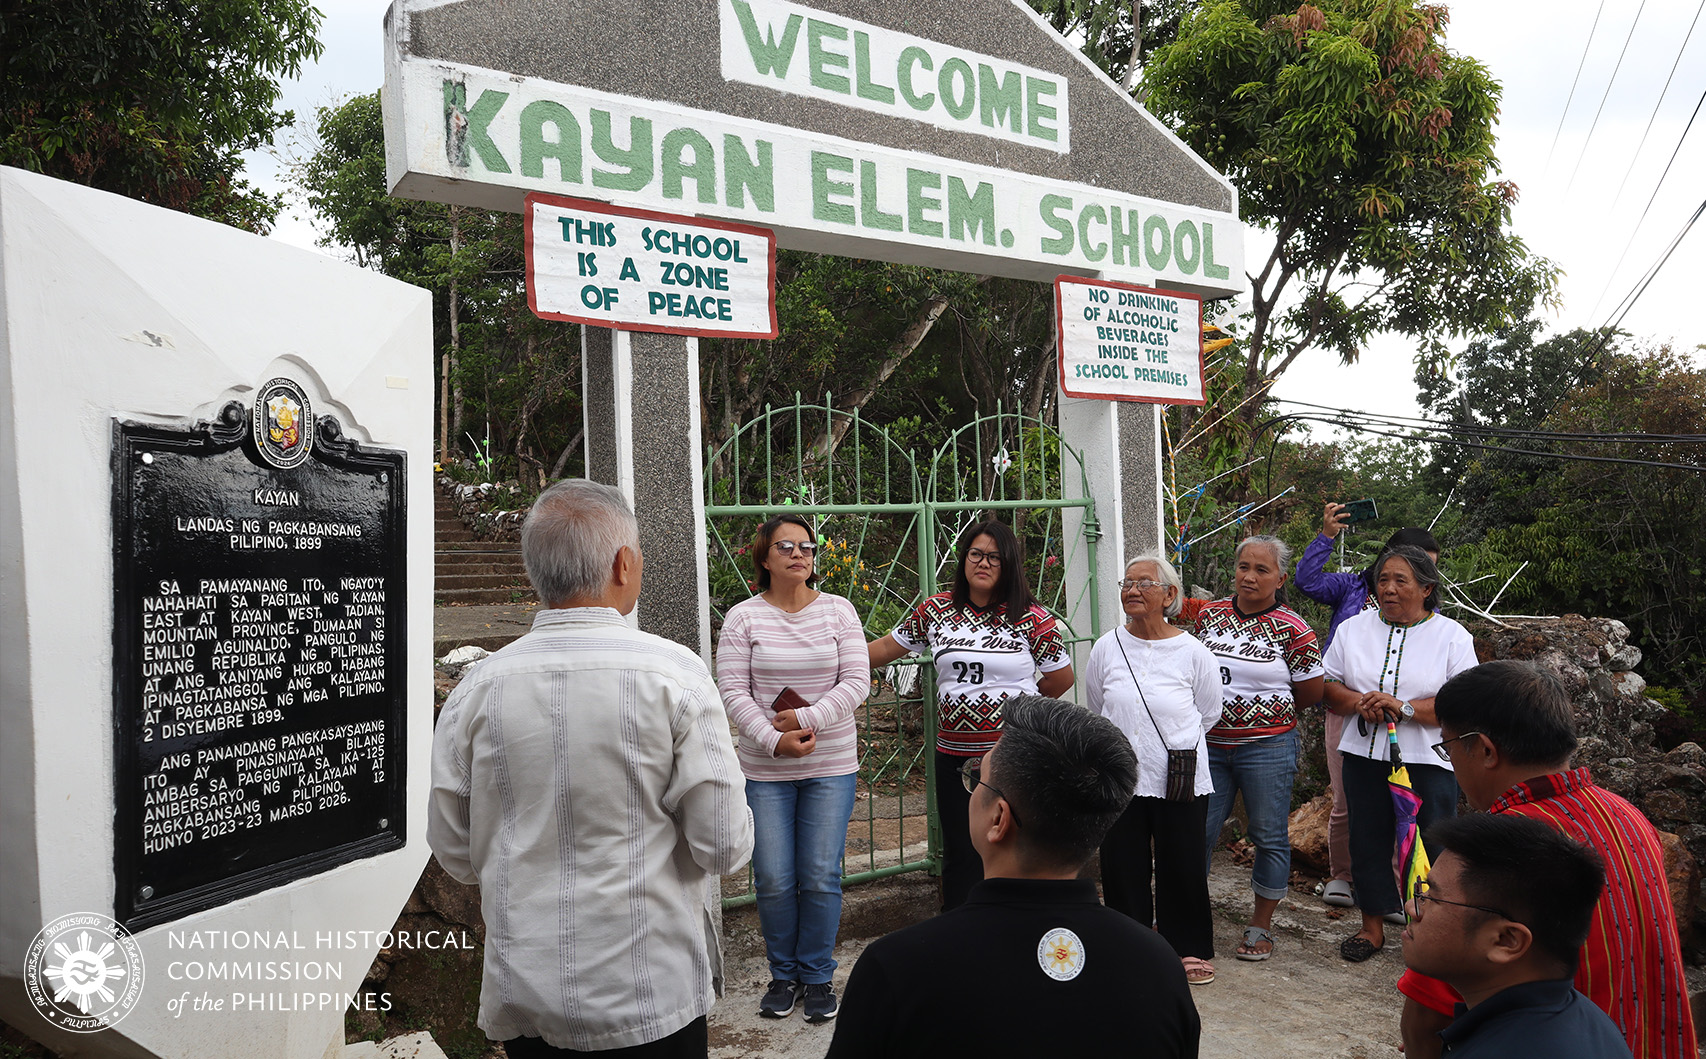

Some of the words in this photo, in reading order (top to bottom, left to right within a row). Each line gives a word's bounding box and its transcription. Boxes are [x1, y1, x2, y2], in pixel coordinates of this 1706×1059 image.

[730, 0, 1058, 142] WELCOME
[443, 79, 775, 212] KAYAN
[811, 150, 1014, 248] ELEM.
[1040, 193, 1230, 280] SCHOOL
[558, 216, 617, 247] THIS
[641, 227, 748, 263] SCHOOL
[578, 252, 598, 277] IS
[619, 257, 640, 282] A
[660, 262, 729, 291] ZONE
[581, 285, 619, 310] OF
[648, 291, 732, 321] PEACE
[1088, 288, 1109, 303] NO
[1118, 292, 1178, 314] DRINKING
[1084, 307, 1100, 321] OF
[1107, 309, 1178, 332] ALCOHOLIC
[1096, 326, 1168, 347] BEVERAGES
[1098, 345, 1138, 361] INSIDE
[1145, 348, 1168, 363] THE
[264, 379, 298, 390] HISTORICAL
[1075, 364, 1128, 379] SCHOOL
[1134, 367, 1188, 386] PREMISES
[254, 489, 299, 506] KAYAN
[176, 518, 234, 533] LANDAS
[242, 520, 260, 533] NG
[269, 521, 361, 537] PAGKABANSANG
[230, 536, 288, 549] PILIPINO,
[295, 537, 321, 549] 1899
[160, 581, 180, 595] SA
[201, 579, 287, 594] PAMAYANANG
[303, 579, 325, 591] ITO,
[341, 578, 384, 590] NGAYO'Y
[143, 596, 217, 611] NAHAHATI
[231, 595, 248, 608] SA
[261, 593, 310, 607] PAGITAN
[323, 592, 339, 604] NG
[353, 591, 385, 603] KAYAN
[144, 613, 183, 628] EAST
[199, 611, 215, 626] AT
[231, 609, 271, 623] KAYAN
[287, 607, 323, 620] WEST,
[345, 604, 384, 617] TADIAN,
[144, 626, 217, 644] MOUNTAIN
[232, 622, 299, 638] PROVINCE,
[313, 619, 362, 633] DUMAAN
[376, 617, 384, 629] SI
[981, 635, 1023, 650] West
[144, 644, 195, 660] EMILIO
[214, 636, 291, 654] AGUINALDO,
[305, 632, 356, 646] PANGULO
[371, 630, 384, 642] NG
[1239, 642, 1276, 659] West
[143, 659, 194, 677] UNANG
[212, 651, 286, 670] REPUBLIKA
[301, 648, 317, 661] NG
[331, 643, 384, 658] PILIPINAS,
[952, 661, 984, 685] 23
[144, 678, 161, 693] AT
[175, 674, 204, 690] ANG
[220, 666, 282, 685] KANIYANG
[293, 661, 332, 677] HUKBO
[341, 656, 384, 671] HABANG
[1220, 666, 1232, 685] 3
[143, 682, 268, 710] IPINAGTATANGGOL
[287, 677, 312, 691] ANG
[331, 669, 384, 685] KALAYAAN
[145, 710, 161, 726] AT
[176, 697, 267, 720] PAGKABANSA
[277, 693, 294, 707] NG
[303, 688, 328, 703] MGA
[339, 682, 384, 698] PILIPINO,
[144, 728, 153, 742] 2
[162, 714, 244, 739] DISYEMBRE
[252, 709, 284, 725] 1899.
[160, 754, 191, 771] ANG
[198, 739, 276, 764] PANANDANG
[282, 720, 384, 749] PANGKASAYSAYANG
[144, 774, 167, 790] ITO
[194, 766, 210, 781] AY
[236, 744, 324, 772] PINASINAYAAN
[347, 733, 384, 750] BILANG
[144, 783, 199, 807] AMBAG
[209, 777, 227, 792] SA
[238, 762, 305, 786] PAGGUNITA
[315, 757, 330, 770] SA
[341, 745, 384, 764] IKA-125
[144, 789, 244, 823] ANIBERSARYO
[263, 781, 280, 795] NG
[298, 764, 357, 787] KALAYAAN
[372, 758, 384, 771] AT
[144, 800, 260, 839] PAGKABANSANG
[293, 781, 344, 802] PILIPINO,
[374, 771, 384, 783] 12
[144, 830, 193, 855] HUNYO
[270, 801, 312, 822] MARSO
[319, 792, 351, 810] 2026.
